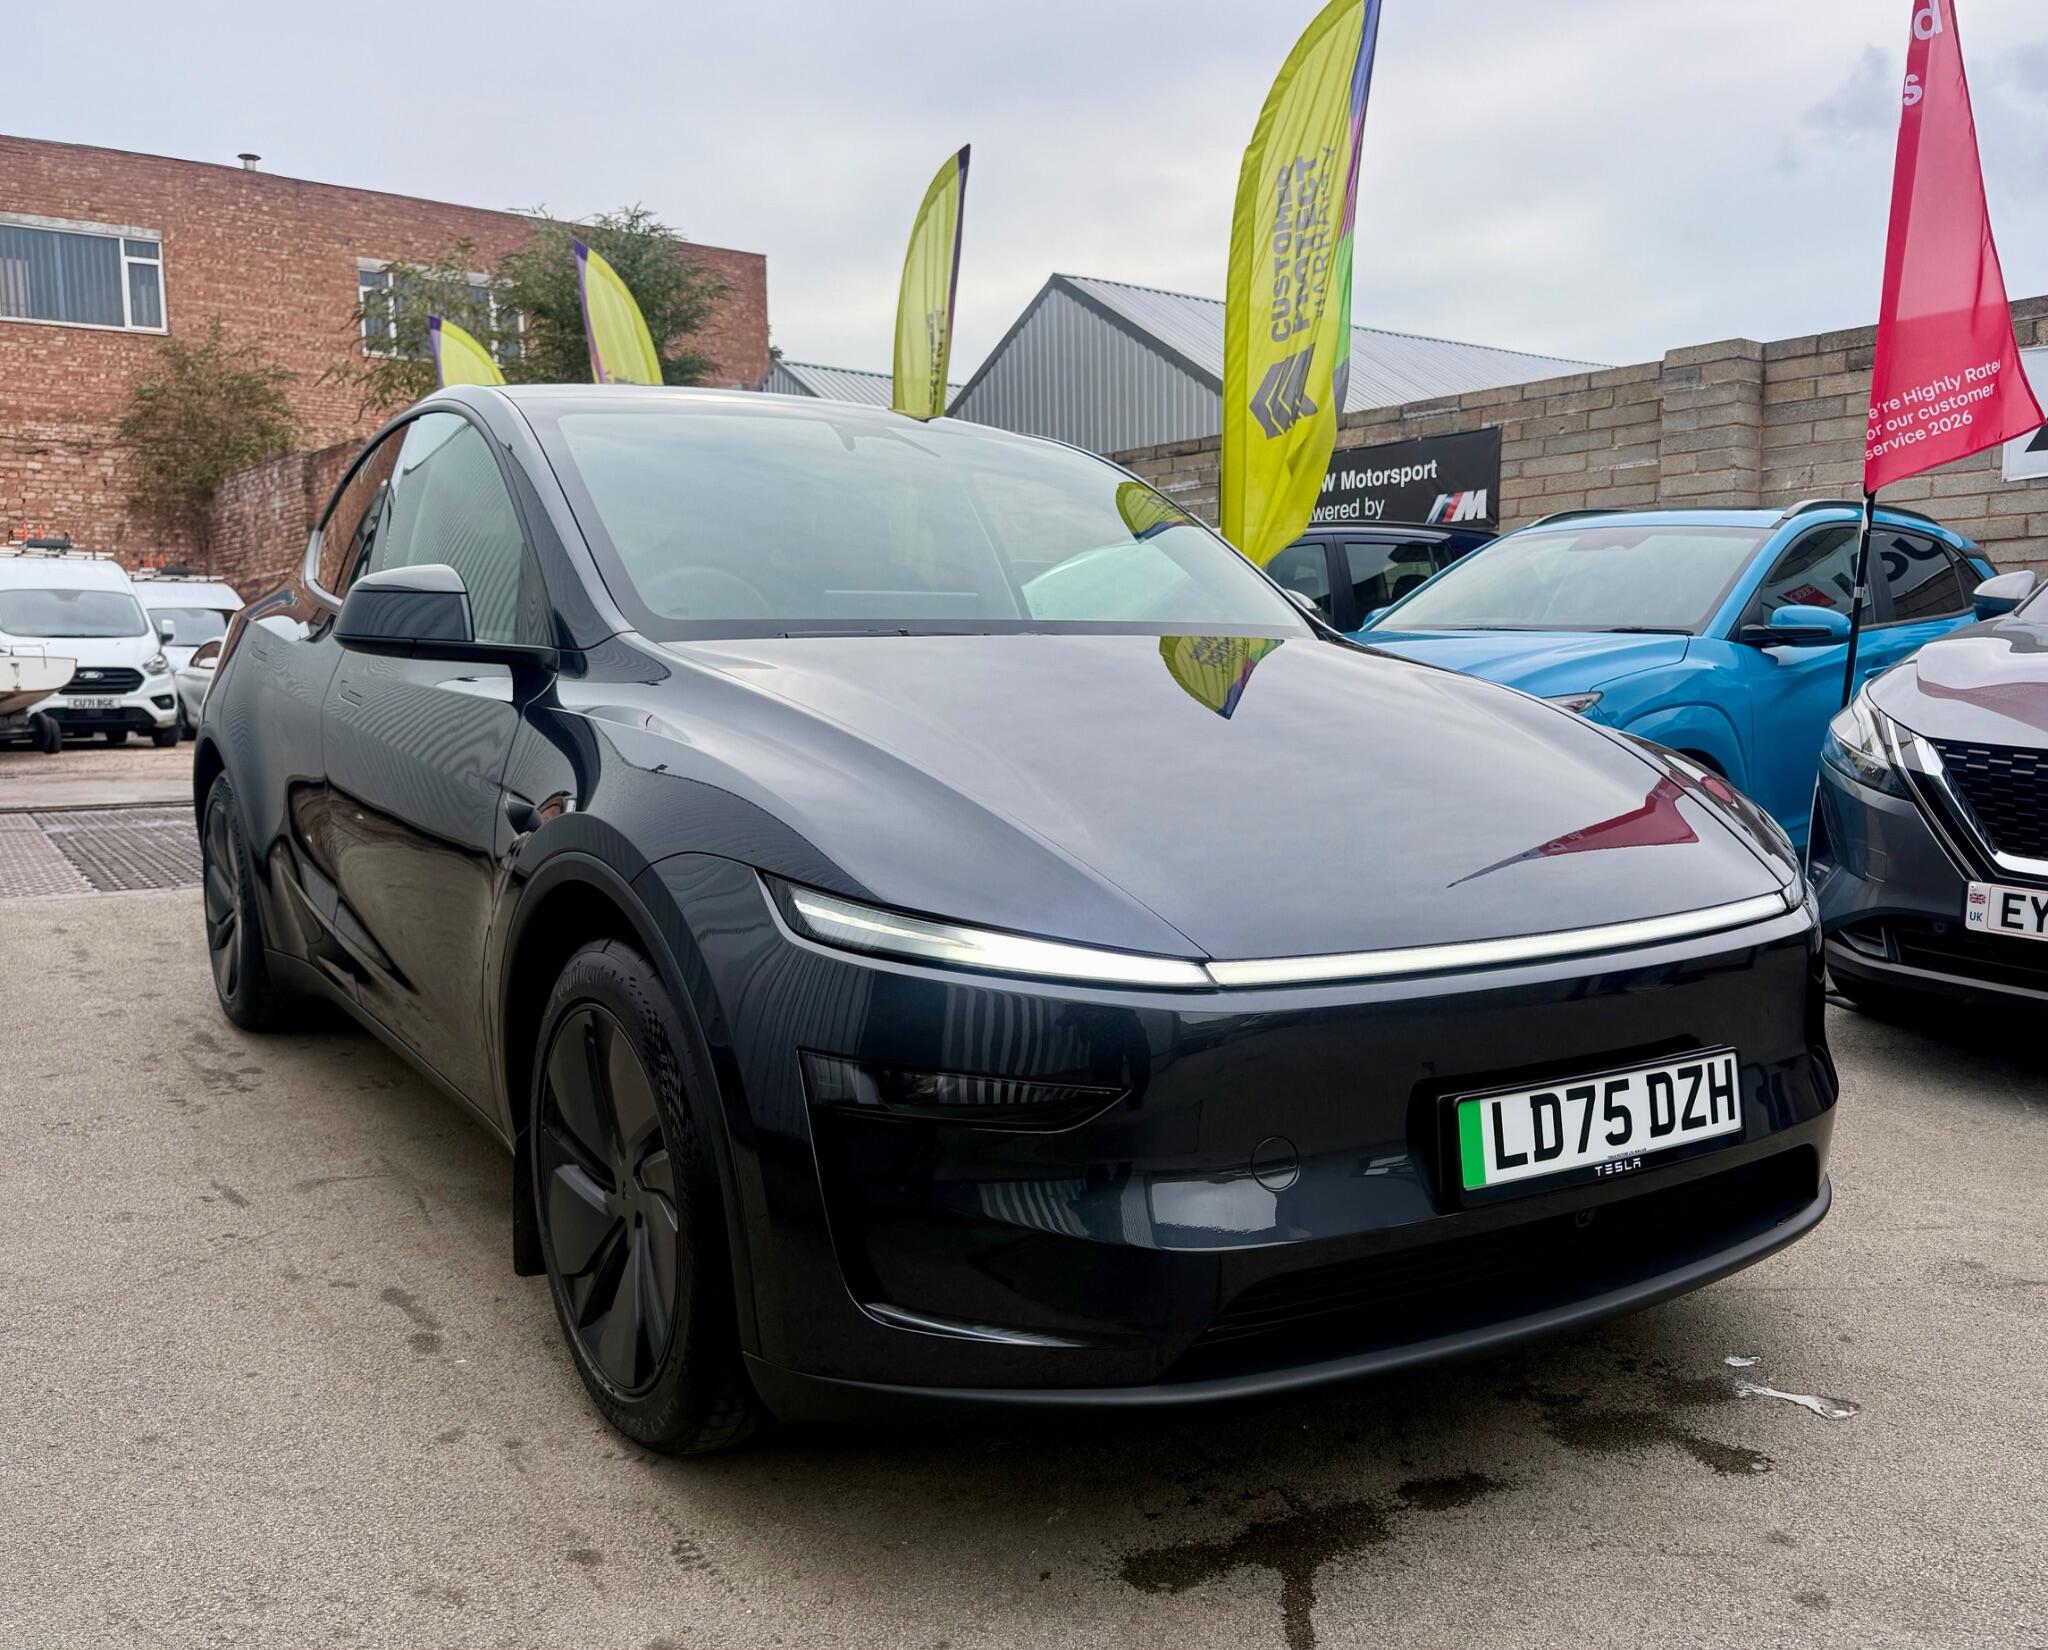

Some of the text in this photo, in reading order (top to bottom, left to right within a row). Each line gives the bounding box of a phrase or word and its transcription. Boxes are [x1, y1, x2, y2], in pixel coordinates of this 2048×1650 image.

[1866, 383, 1995, 441] or our customer
[1868, 399, 1901, 420] e're
[1902, 375, 1961, 405] Highly
[1865, 410, 1973, 461] service 2026
[1322, 459, 1437, 492] W Motorsport
[1312, 496, 1385, 521] wered by
[1969, 911, 1983, 922] UK
[2000, 892, 2048, 933] EY
[1491, 1058, 1736, 1170] LD75 DZH
[1594, 1157, 1641, 1177] TESLA
